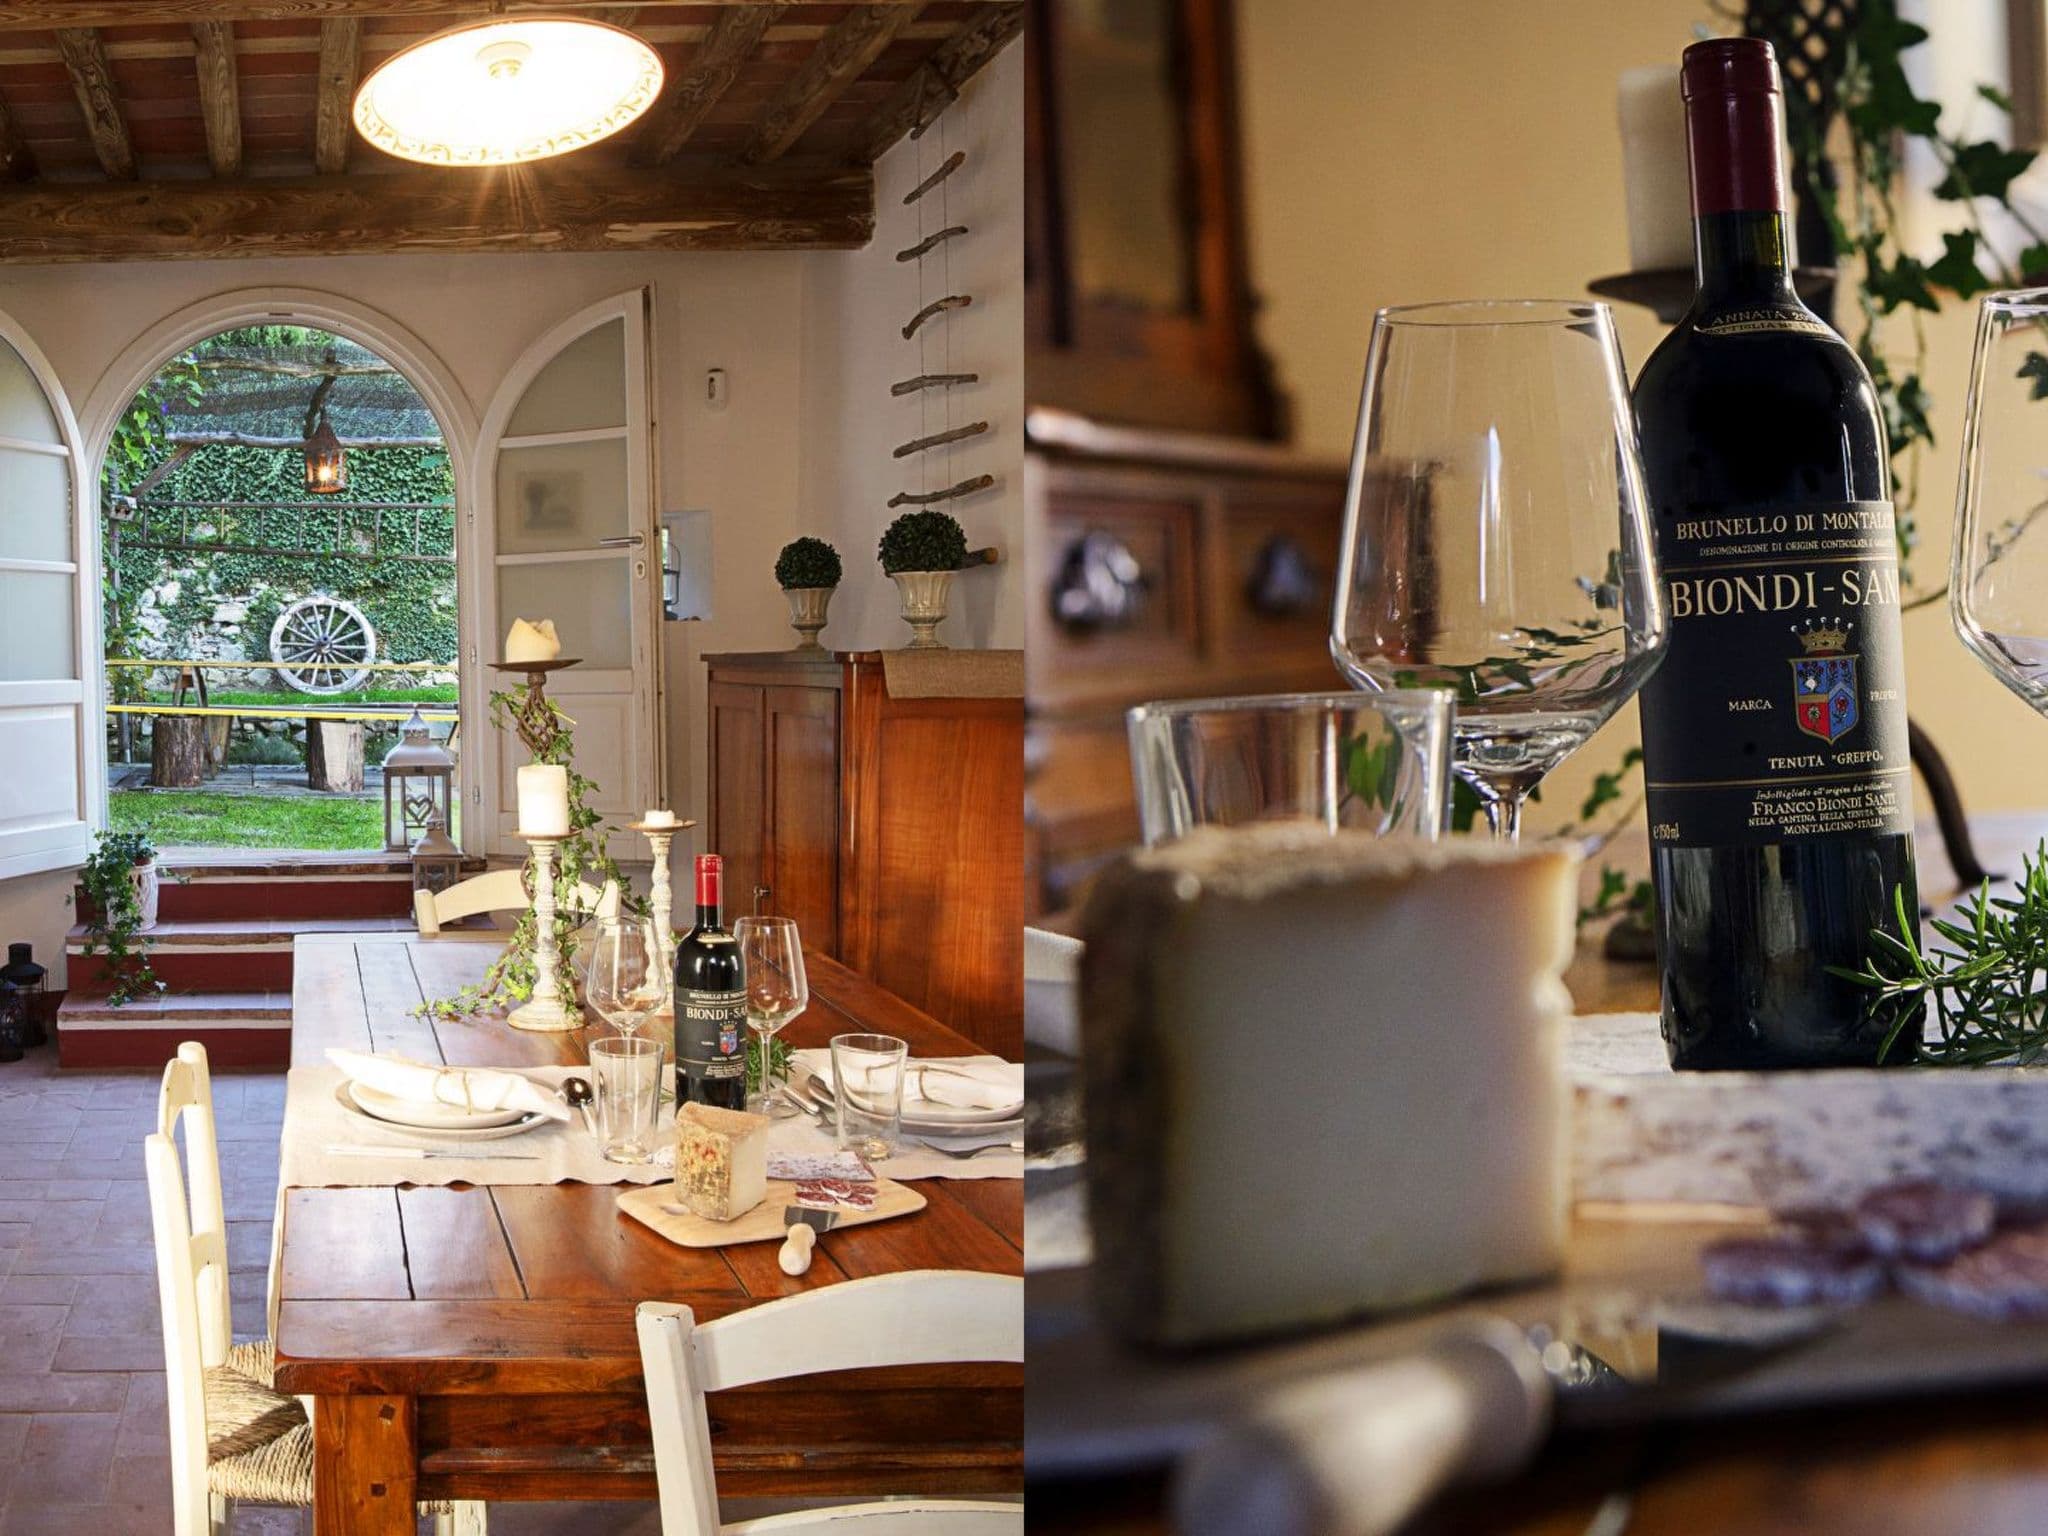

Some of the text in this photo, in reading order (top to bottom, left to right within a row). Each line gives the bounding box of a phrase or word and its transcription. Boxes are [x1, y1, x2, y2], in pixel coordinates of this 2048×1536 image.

[1711, 310, 1787, 327] ANNATA
[1676, 515, 1788, 540] BRUNELLO
[1795, 514, 1814, 532] DI
[1771, 542, 1783, 552] DI
[1785, 541, 1820, 551] ORIGINE
[1728, 699, 1772, 712] MARCA
[1768, 754, 1825, 770] TENUTA
[1752, 801, 1816, 816] FRANCO
[1816, 796, 1862, 812] BIONDI
